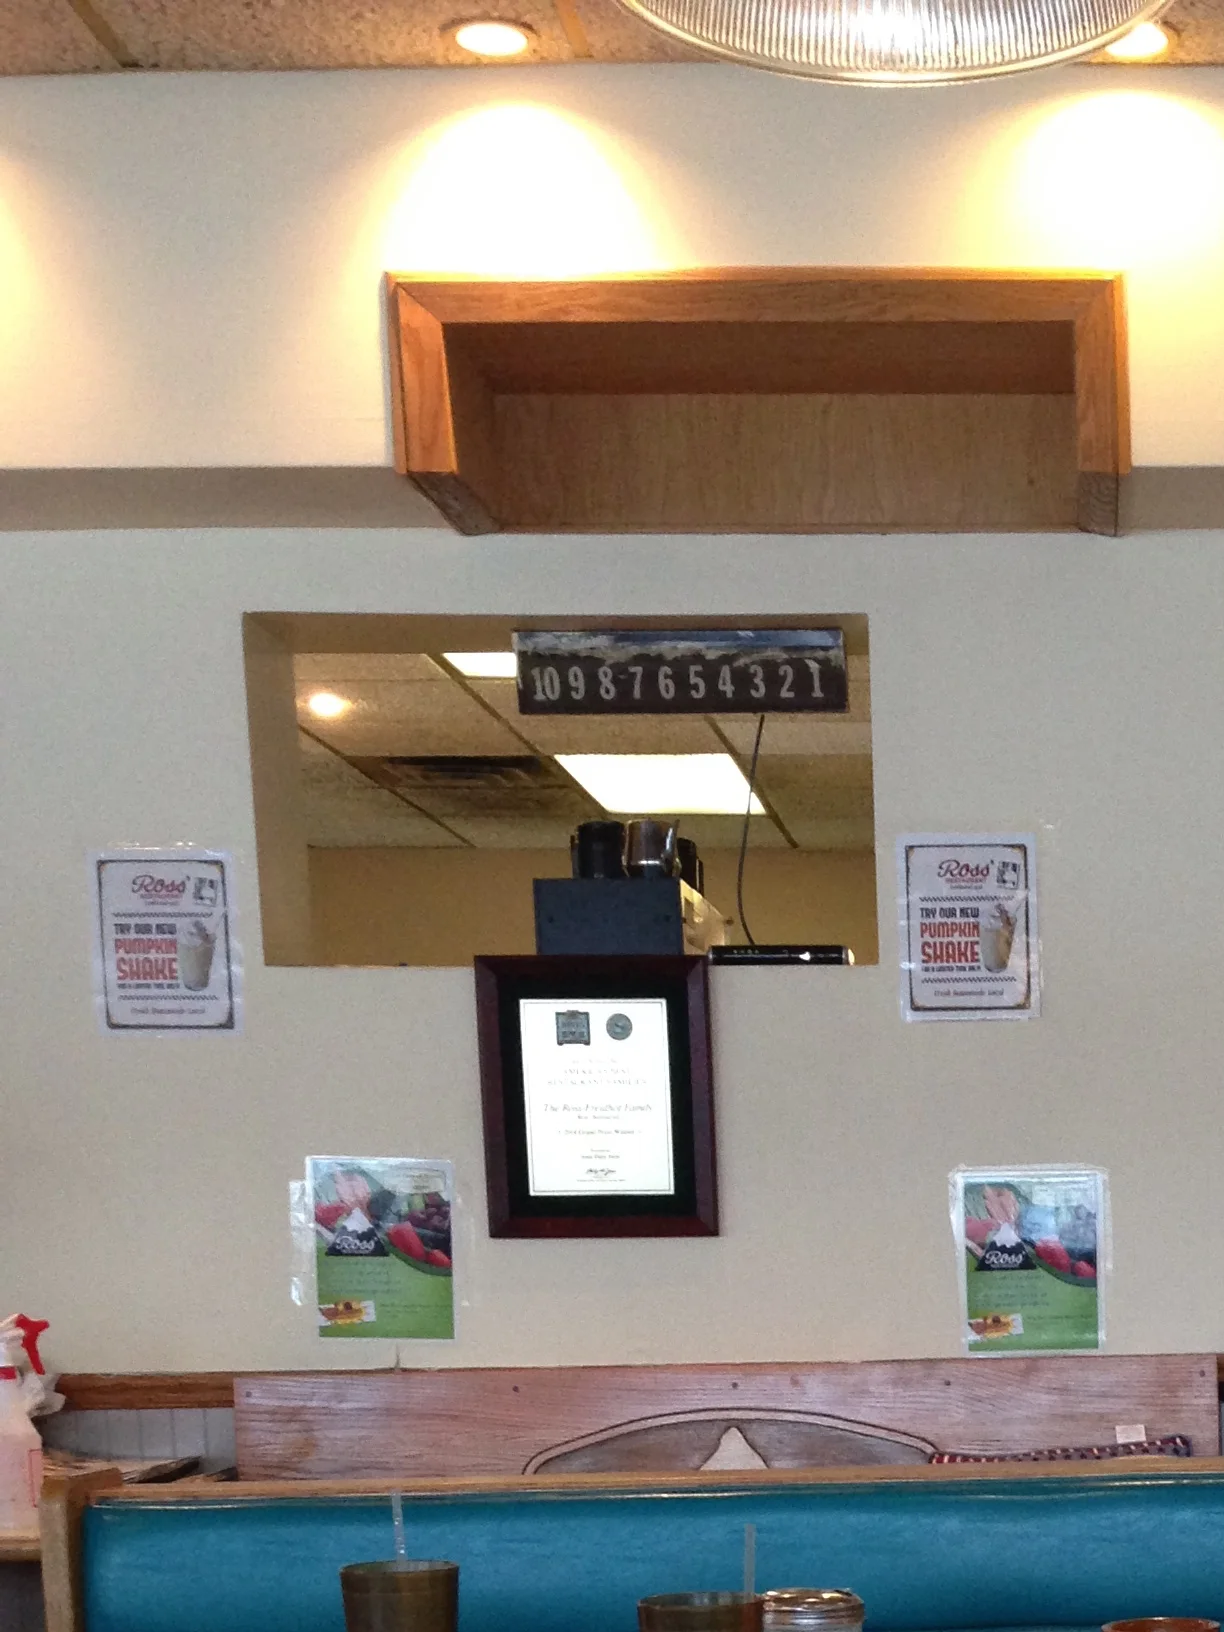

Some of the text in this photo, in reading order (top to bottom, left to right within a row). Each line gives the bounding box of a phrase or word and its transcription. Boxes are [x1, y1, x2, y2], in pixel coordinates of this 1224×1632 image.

[532, 659, 824, 700] 10 9 8 7 6 5 4 3 2 1
[920, 907, 979, 919] TRY OUR NEW
[920, 921, 980, 938] PUMPKIN
[921, 941, 981, 963] SHAKE
[117, 957, 178, 981] SHAKE
